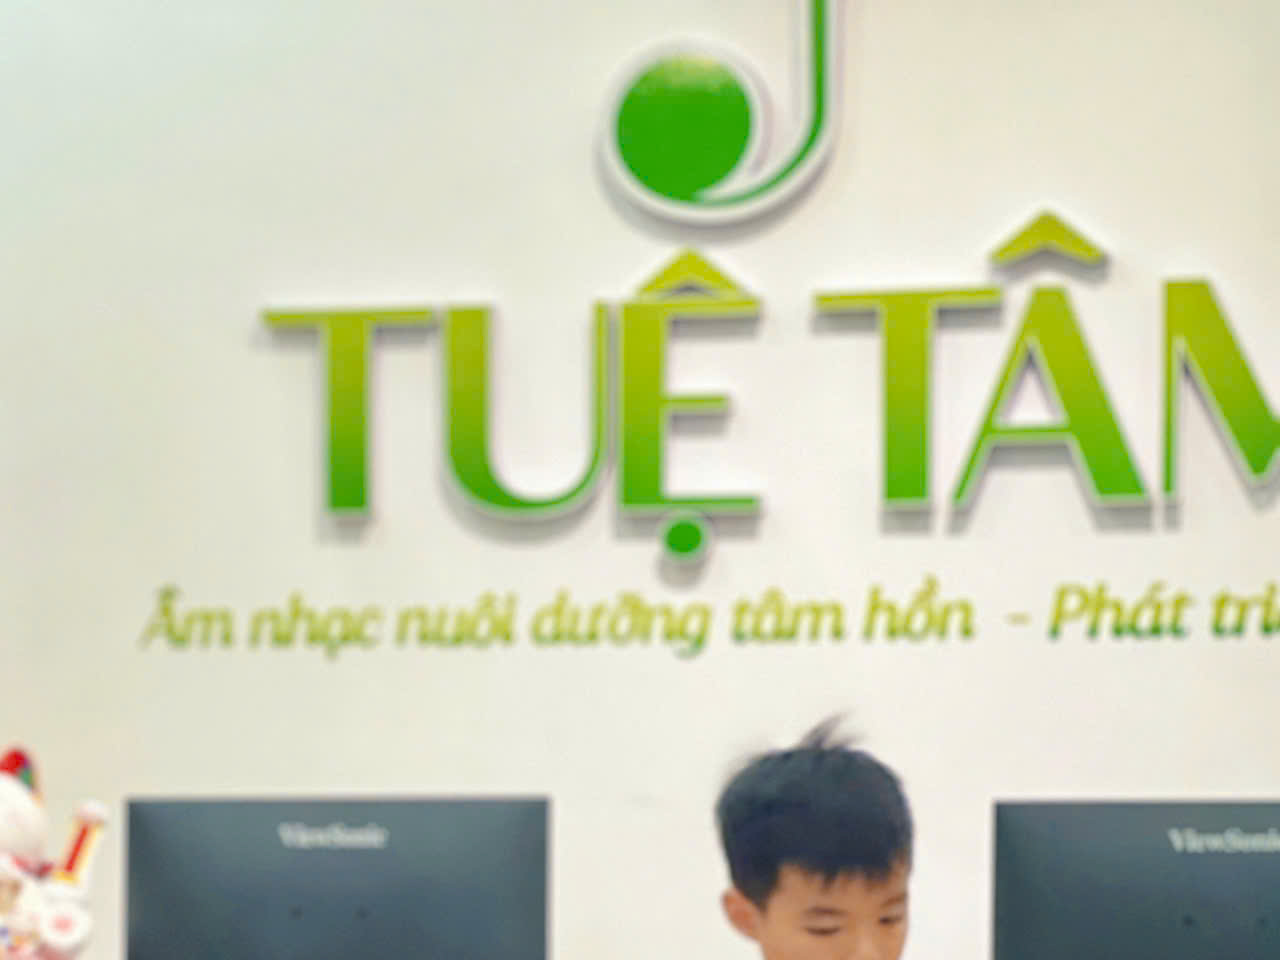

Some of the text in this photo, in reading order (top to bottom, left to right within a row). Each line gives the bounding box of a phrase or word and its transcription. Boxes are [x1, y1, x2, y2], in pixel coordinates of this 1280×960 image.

[261, 209, 1280, 560] TUỆ TÂM
[138, 584, 234, 648] Âm
[248, 589, 380, 661] nhạc
[395, 589, 518, 648] nuôi
[730, 586, 846, 644] tâm
[1047, 581, 1194, 641] Phát
